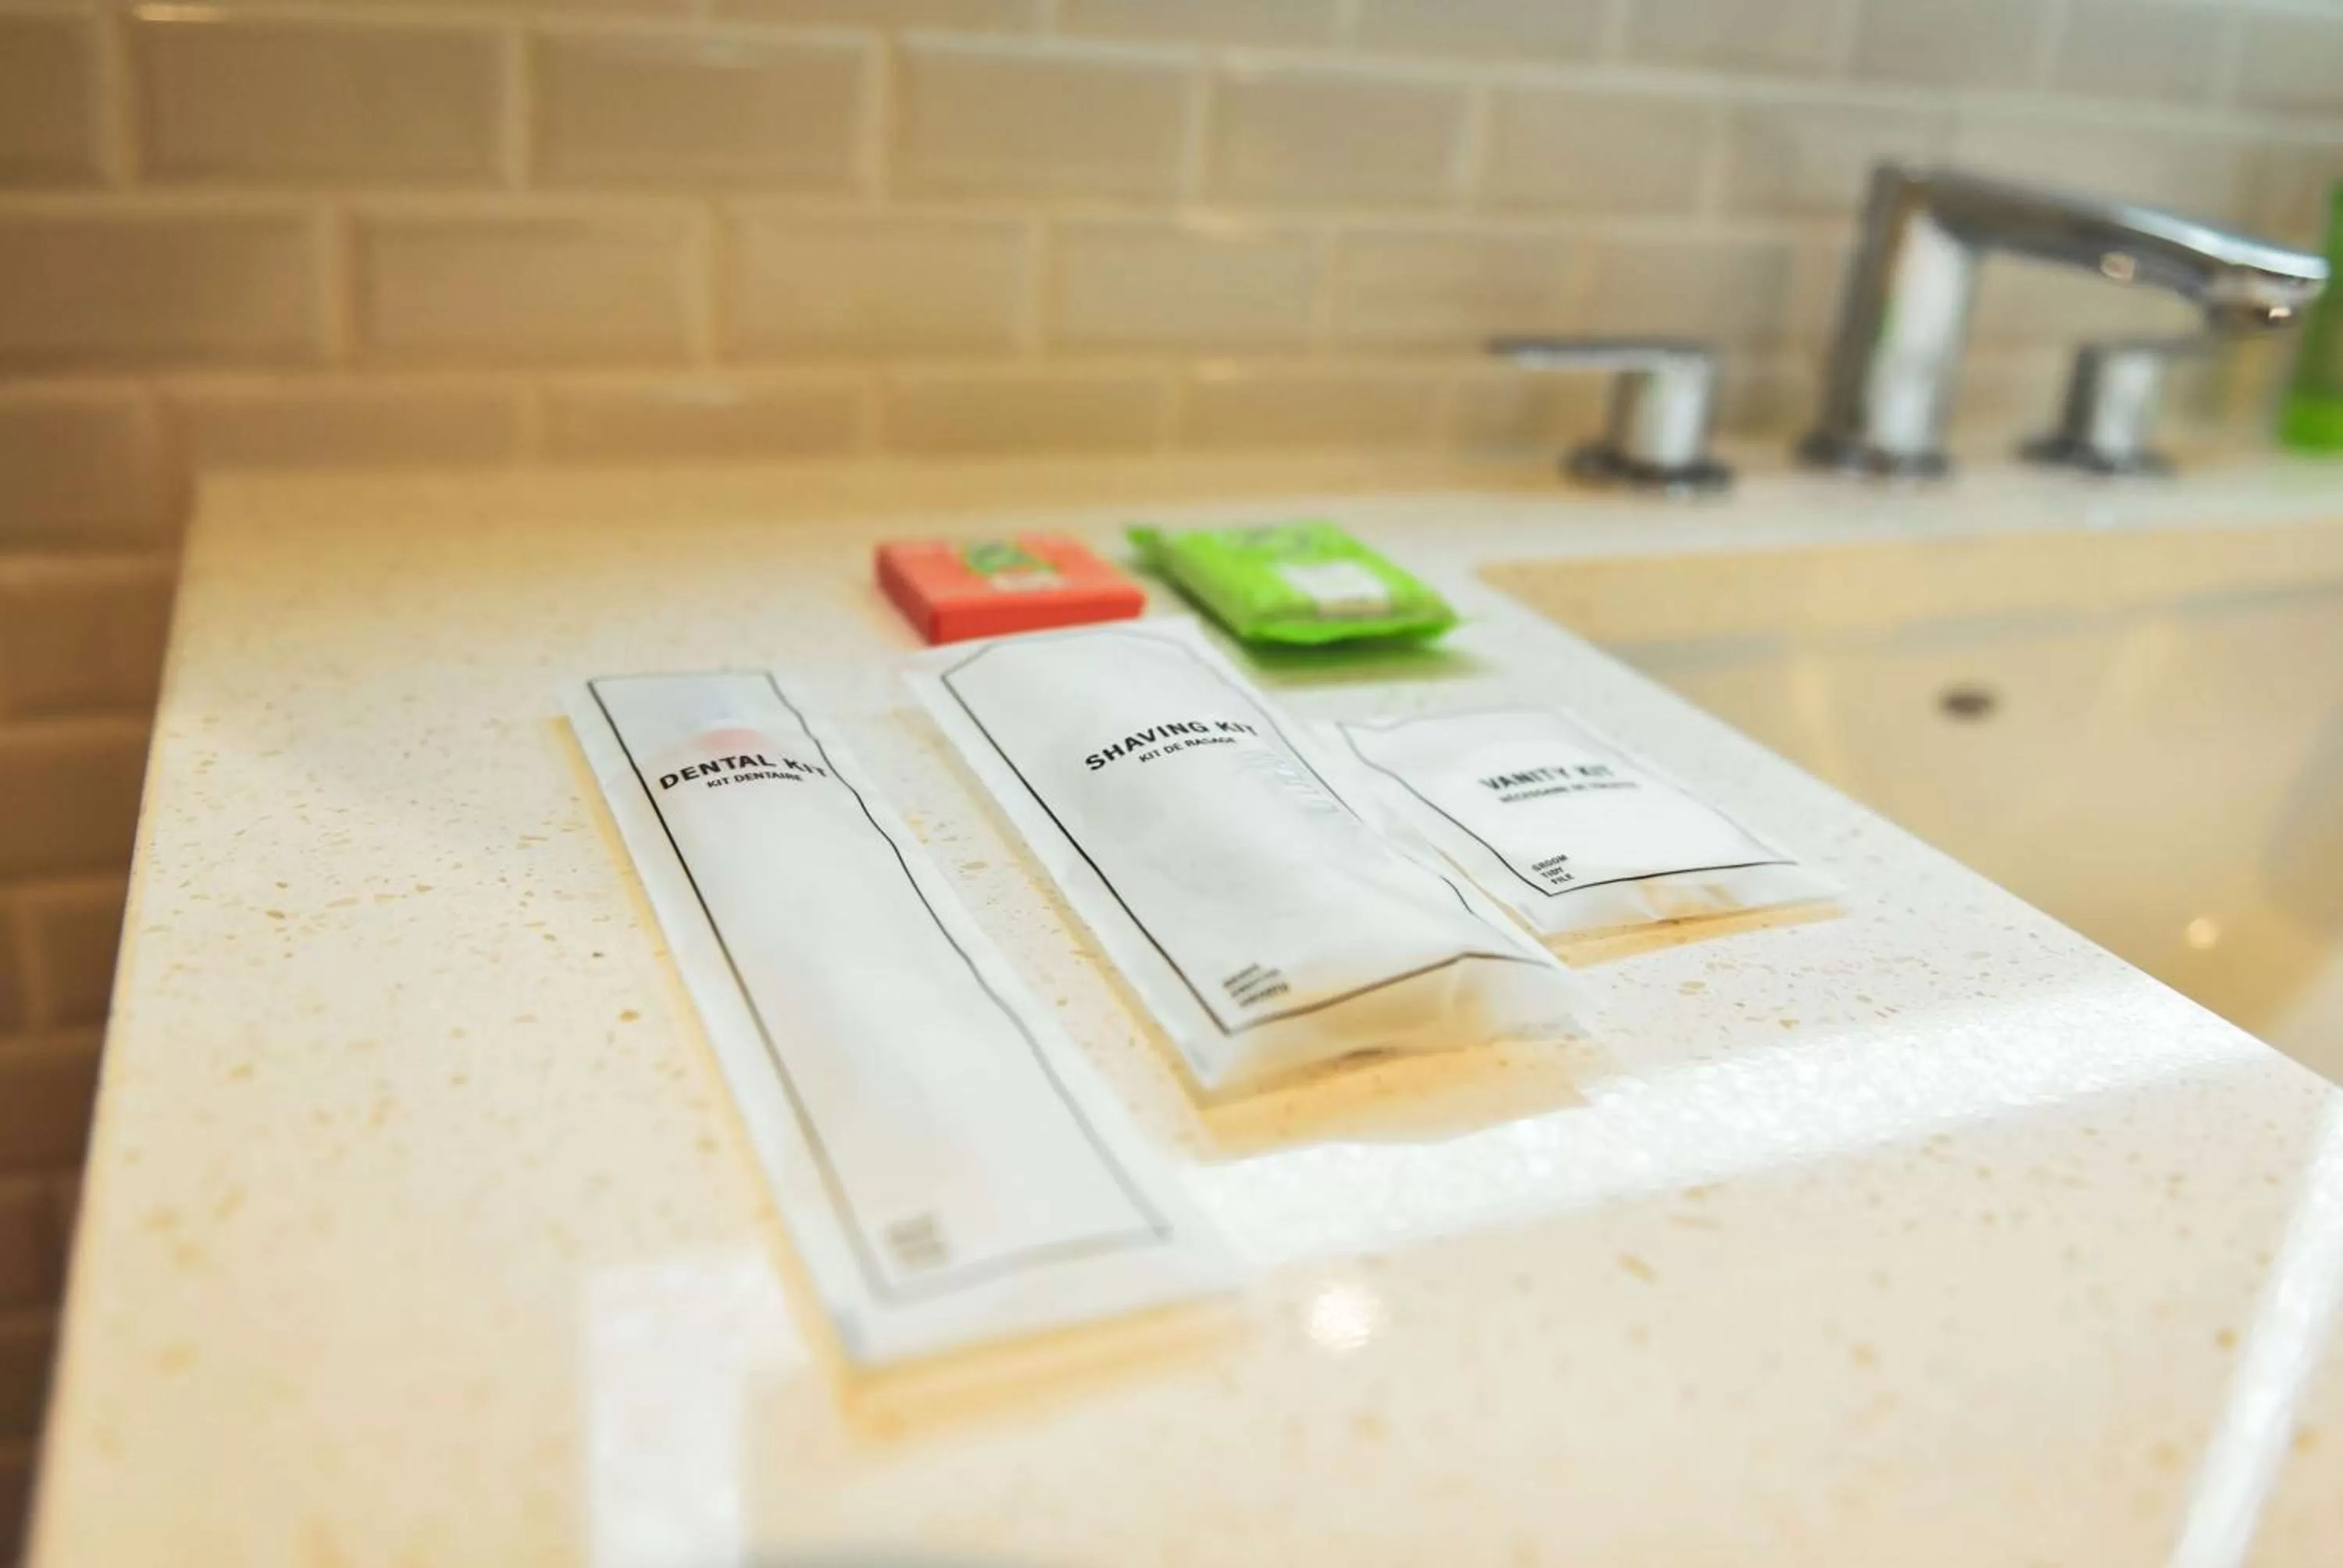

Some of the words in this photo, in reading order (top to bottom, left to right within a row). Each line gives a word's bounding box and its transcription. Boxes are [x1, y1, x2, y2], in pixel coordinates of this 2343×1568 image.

[1085, 722, 1210, 771] SHAVING
[1214, 721, 1258, 737] KIT
[1139, 750, 1161, 762] KIT
[1164, 743, 1183, 754] DE
[660, 754, 776, 789] DENTAL
[783, 758, 826, 778] KIT
[707, 777, 729, 788] KIT
[1478, 766, 1570, 790] VANITY
